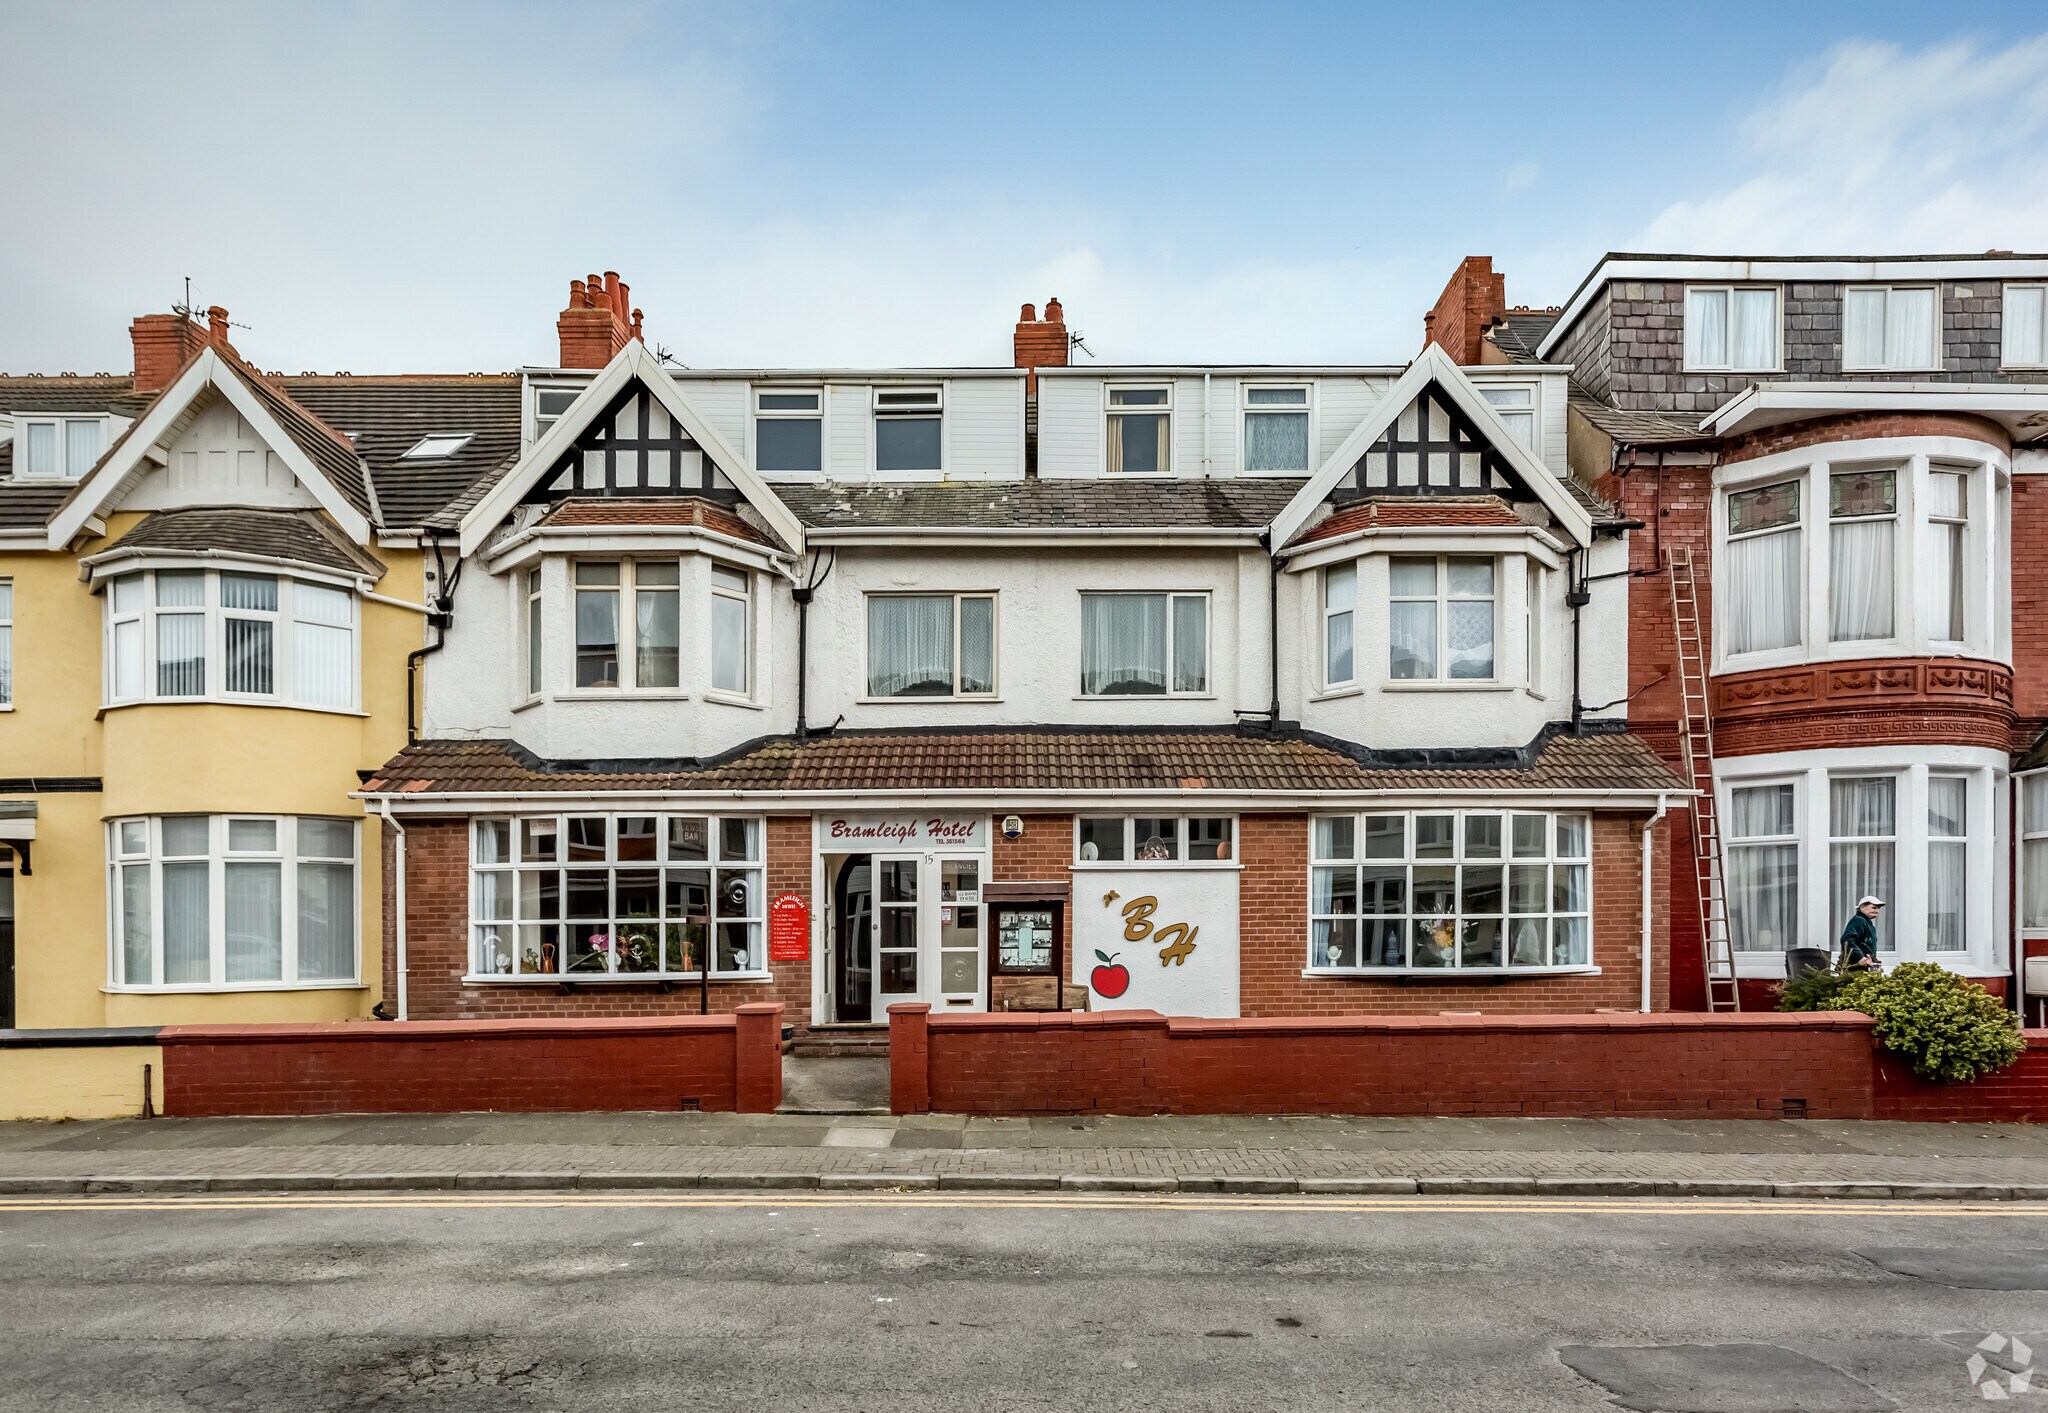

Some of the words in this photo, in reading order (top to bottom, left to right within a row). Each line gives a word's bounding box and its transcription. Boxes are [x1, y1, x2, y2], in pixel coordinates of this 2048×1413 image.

[684, 832, 699, 841] BAR
[831, 819, 917, 844] Bramleigh
[926, 818, 976, 837] Hotel
[925, 854, 934, 866] 15
[773, 895, 805, 909] BRAMLEIGH
[1122, 895, 1158, 941] B
[1154, 922, 1199, 967] H
